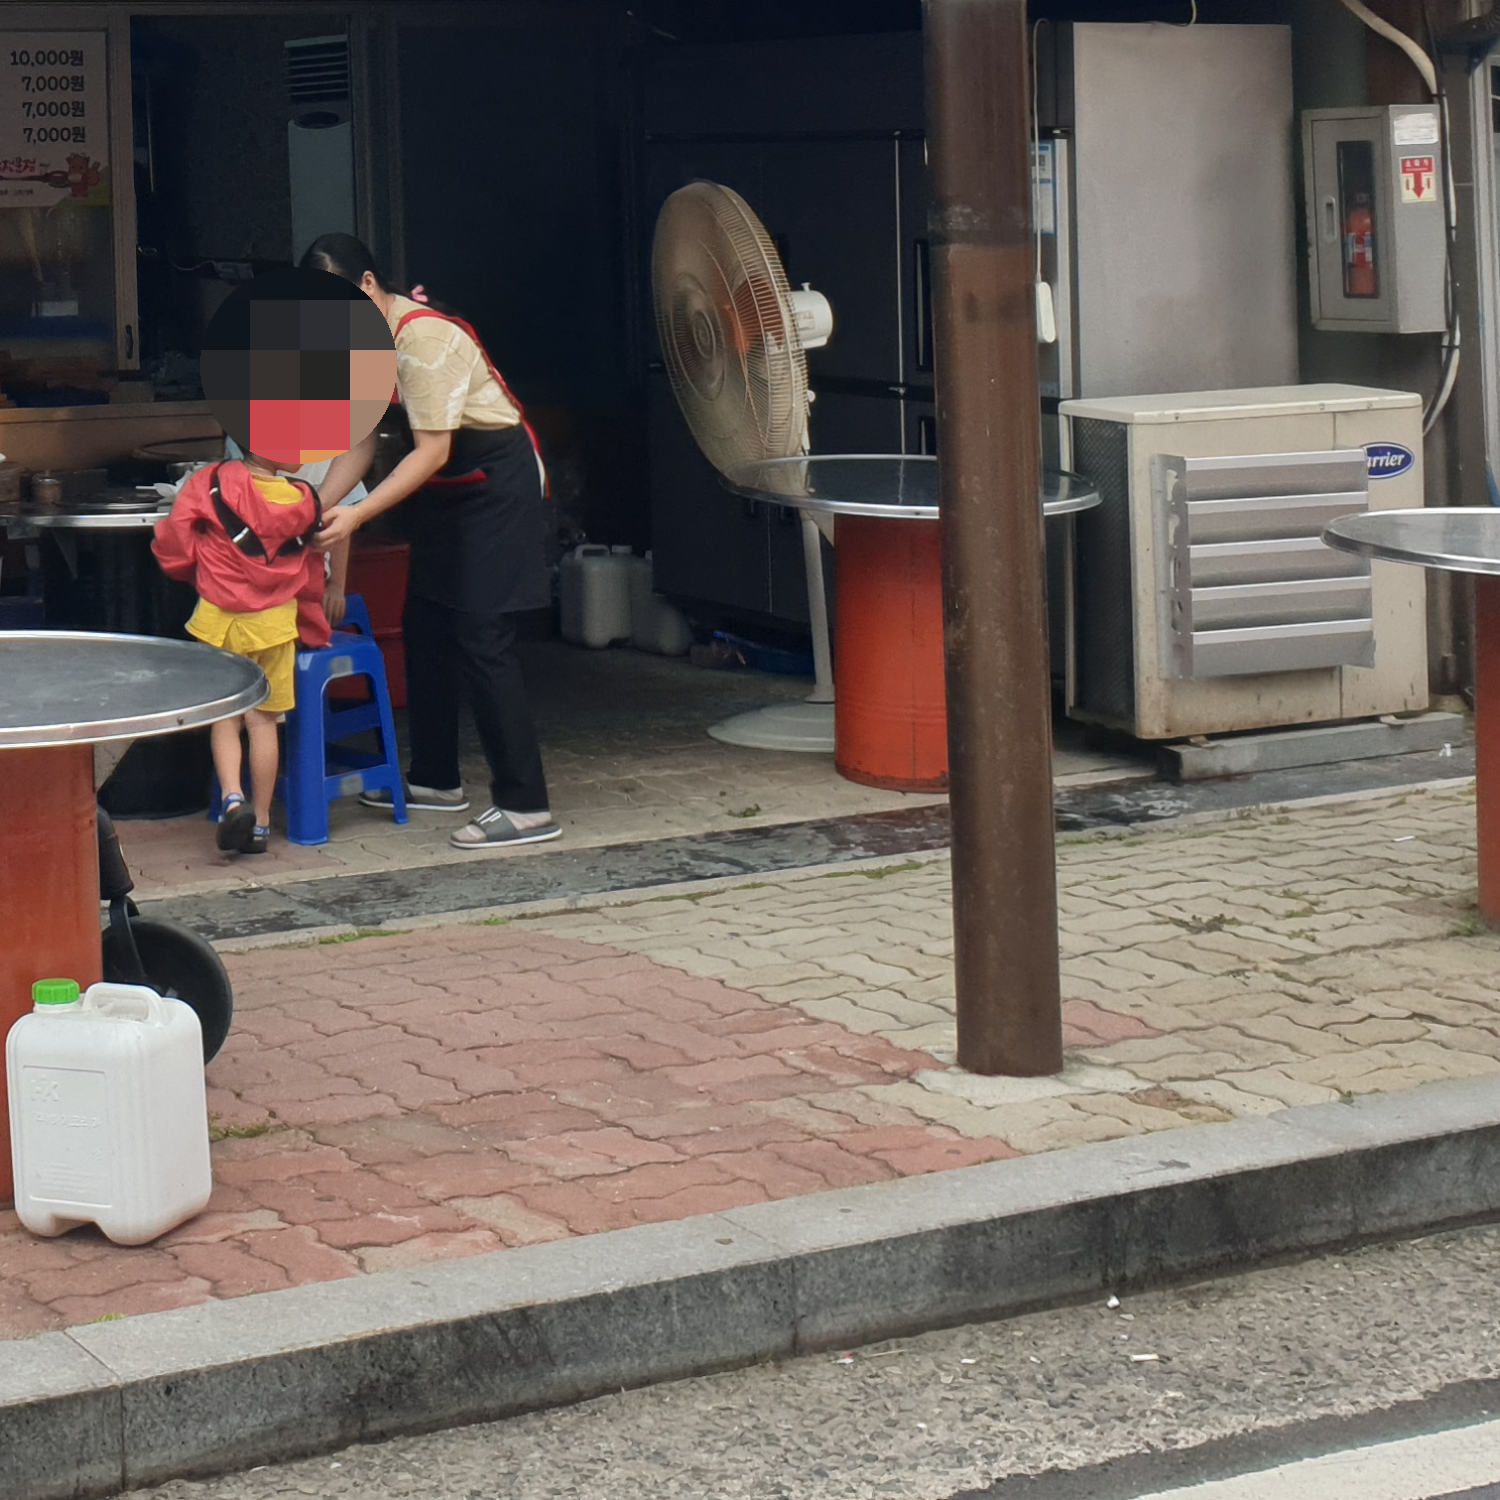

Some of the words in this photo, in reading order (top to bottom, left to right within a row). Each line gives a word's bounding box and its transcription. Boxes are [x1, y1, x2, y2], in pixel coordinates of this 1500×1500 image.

[10, 50, 84, 67] 10,000원
[22, 75, 85, 93] 7,000원
[22, 101, 85, 119] 7,000원
[23, 126, 86, 145] 7,000원
